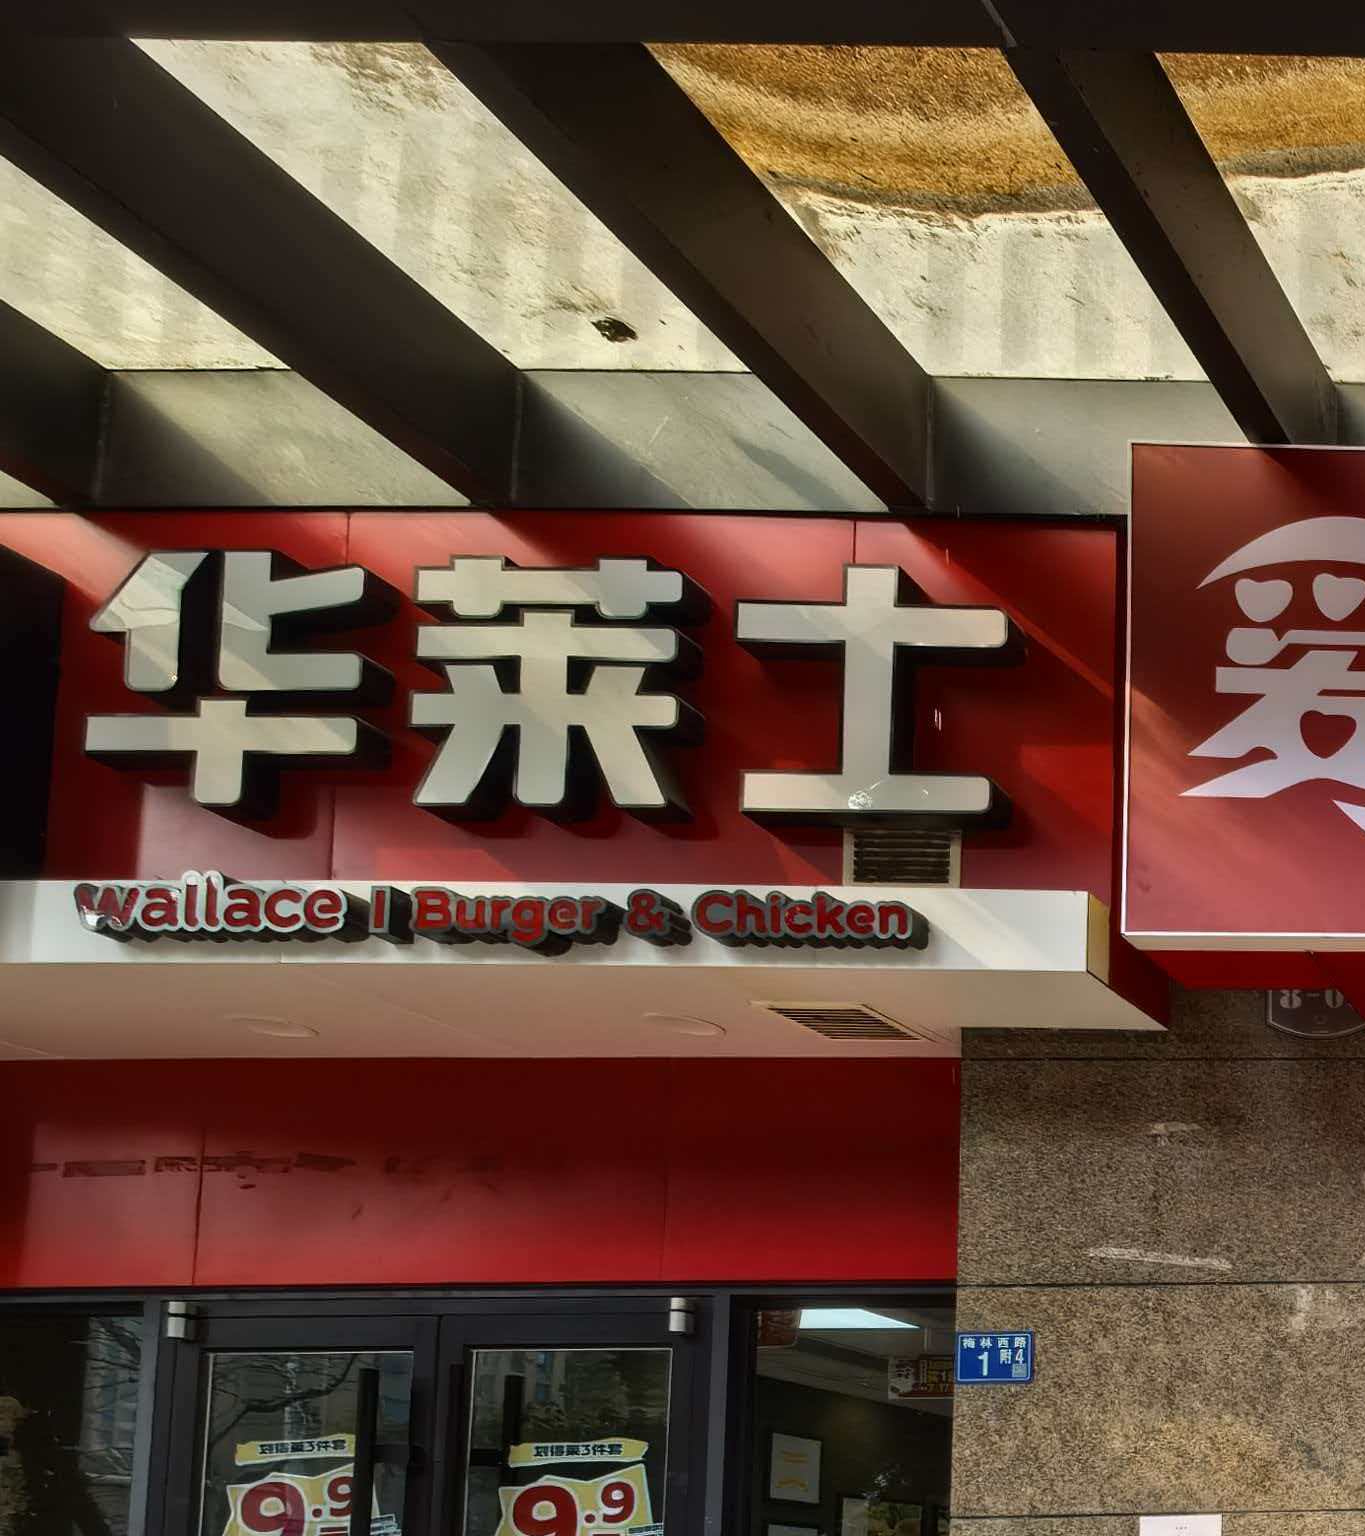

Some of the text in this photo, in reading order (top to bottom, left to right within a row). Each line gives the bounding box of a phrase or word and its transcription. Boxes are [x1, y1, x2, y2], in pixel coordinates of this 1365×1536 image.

[84, 549, 1010, 814] 华莱士
[74, 871, 347, 936] Wallace
[412, 889, 602, 947] Burger
[695, 889, 914, 939] Chicken
[1279, 988, 1345, 1009] 8-0
[961, 1336, 1027, 1350] 梅林西路
[976, 1351, 990, 1377] 1
